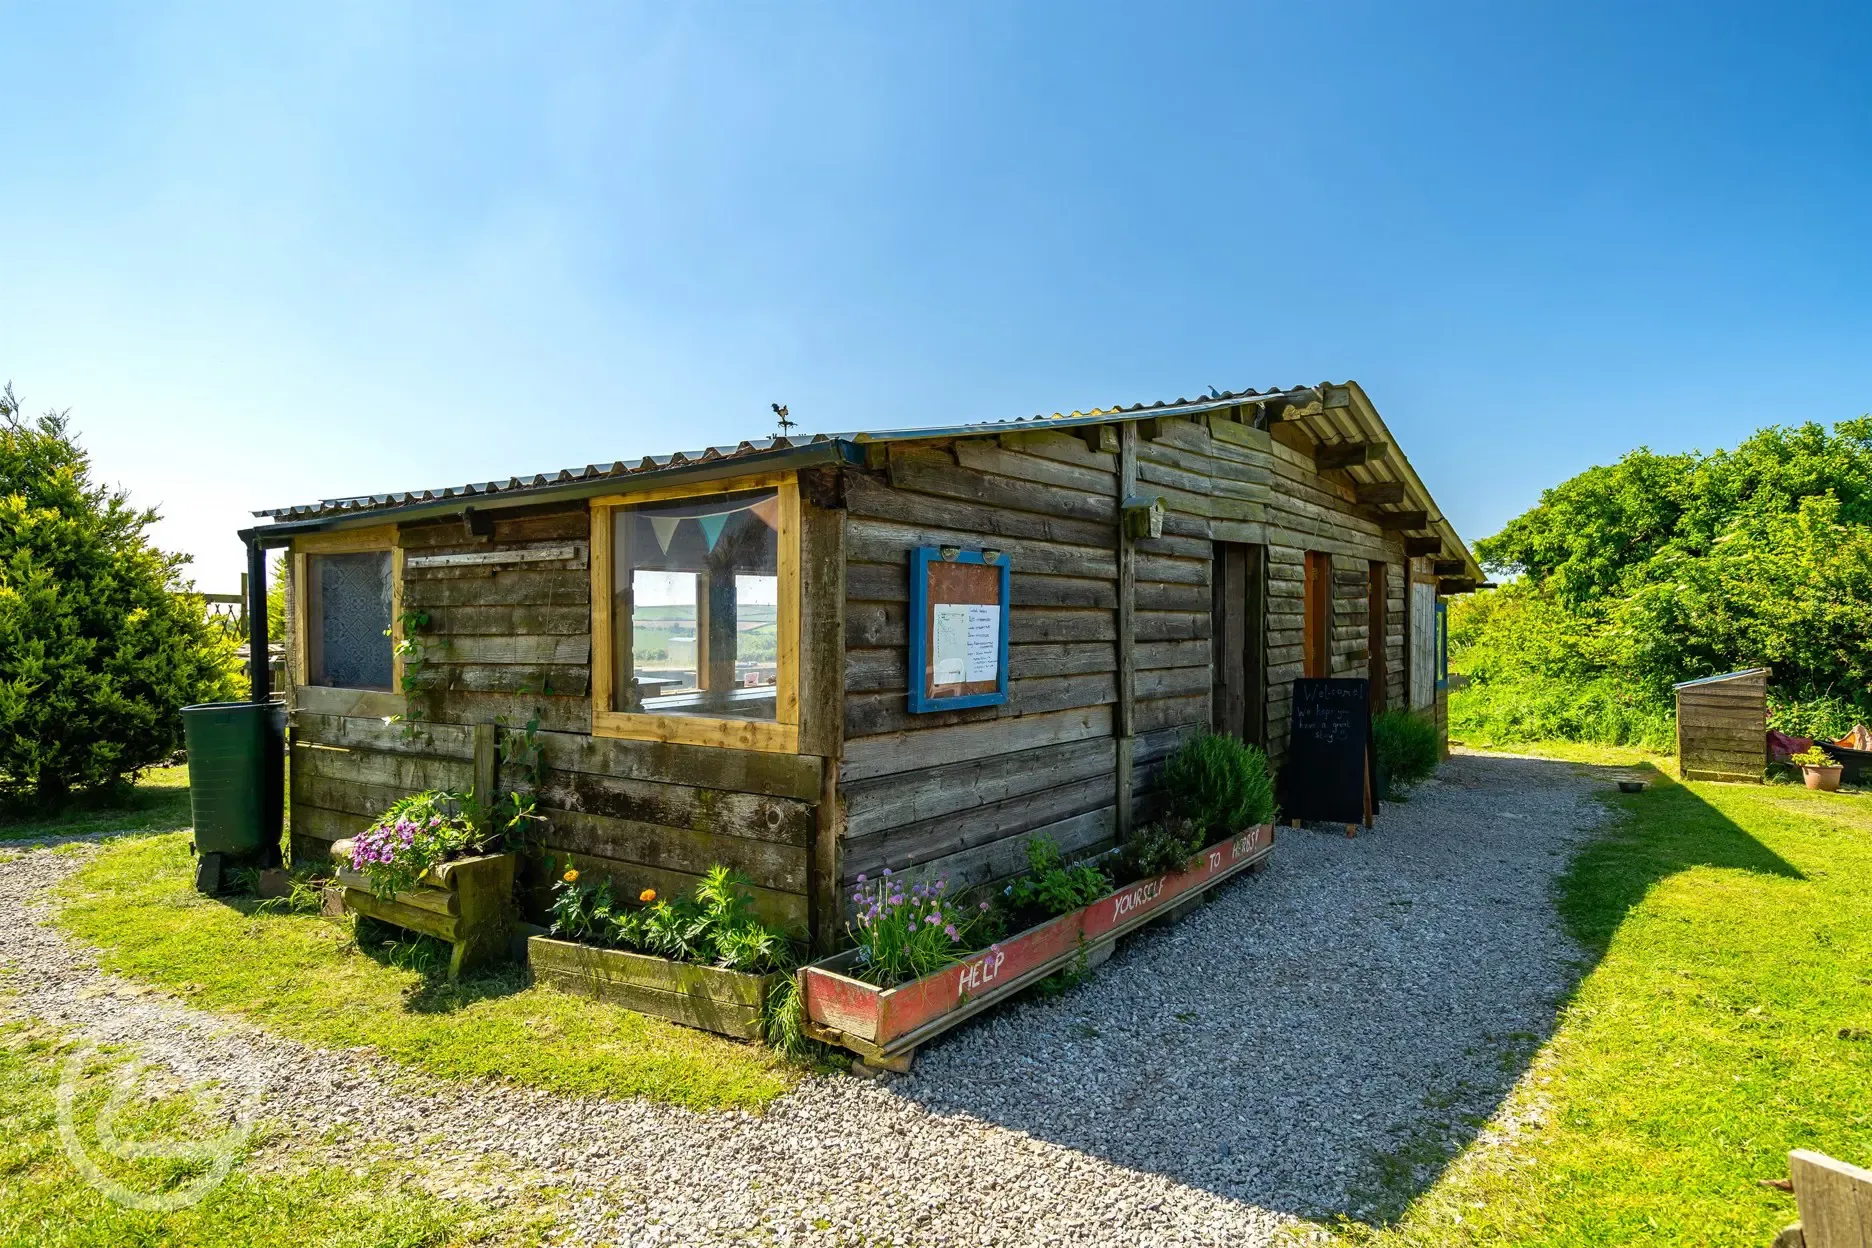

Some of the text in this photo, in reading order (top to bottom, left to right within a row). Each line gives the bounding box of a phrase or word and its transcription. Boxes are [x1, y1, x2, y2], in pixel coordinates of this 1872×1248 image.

[1297, 706, 1311, 717] We
[1316, 704, 1334, 720] hope
[1299, 718, 1316, 729] have
[1315, 729, 1333, 743] stay
[958, 952, 1004, 996] HELP
[1113, 876, 1167, 922] YOURSELF
[1209, 851, 1221, 872] TO
